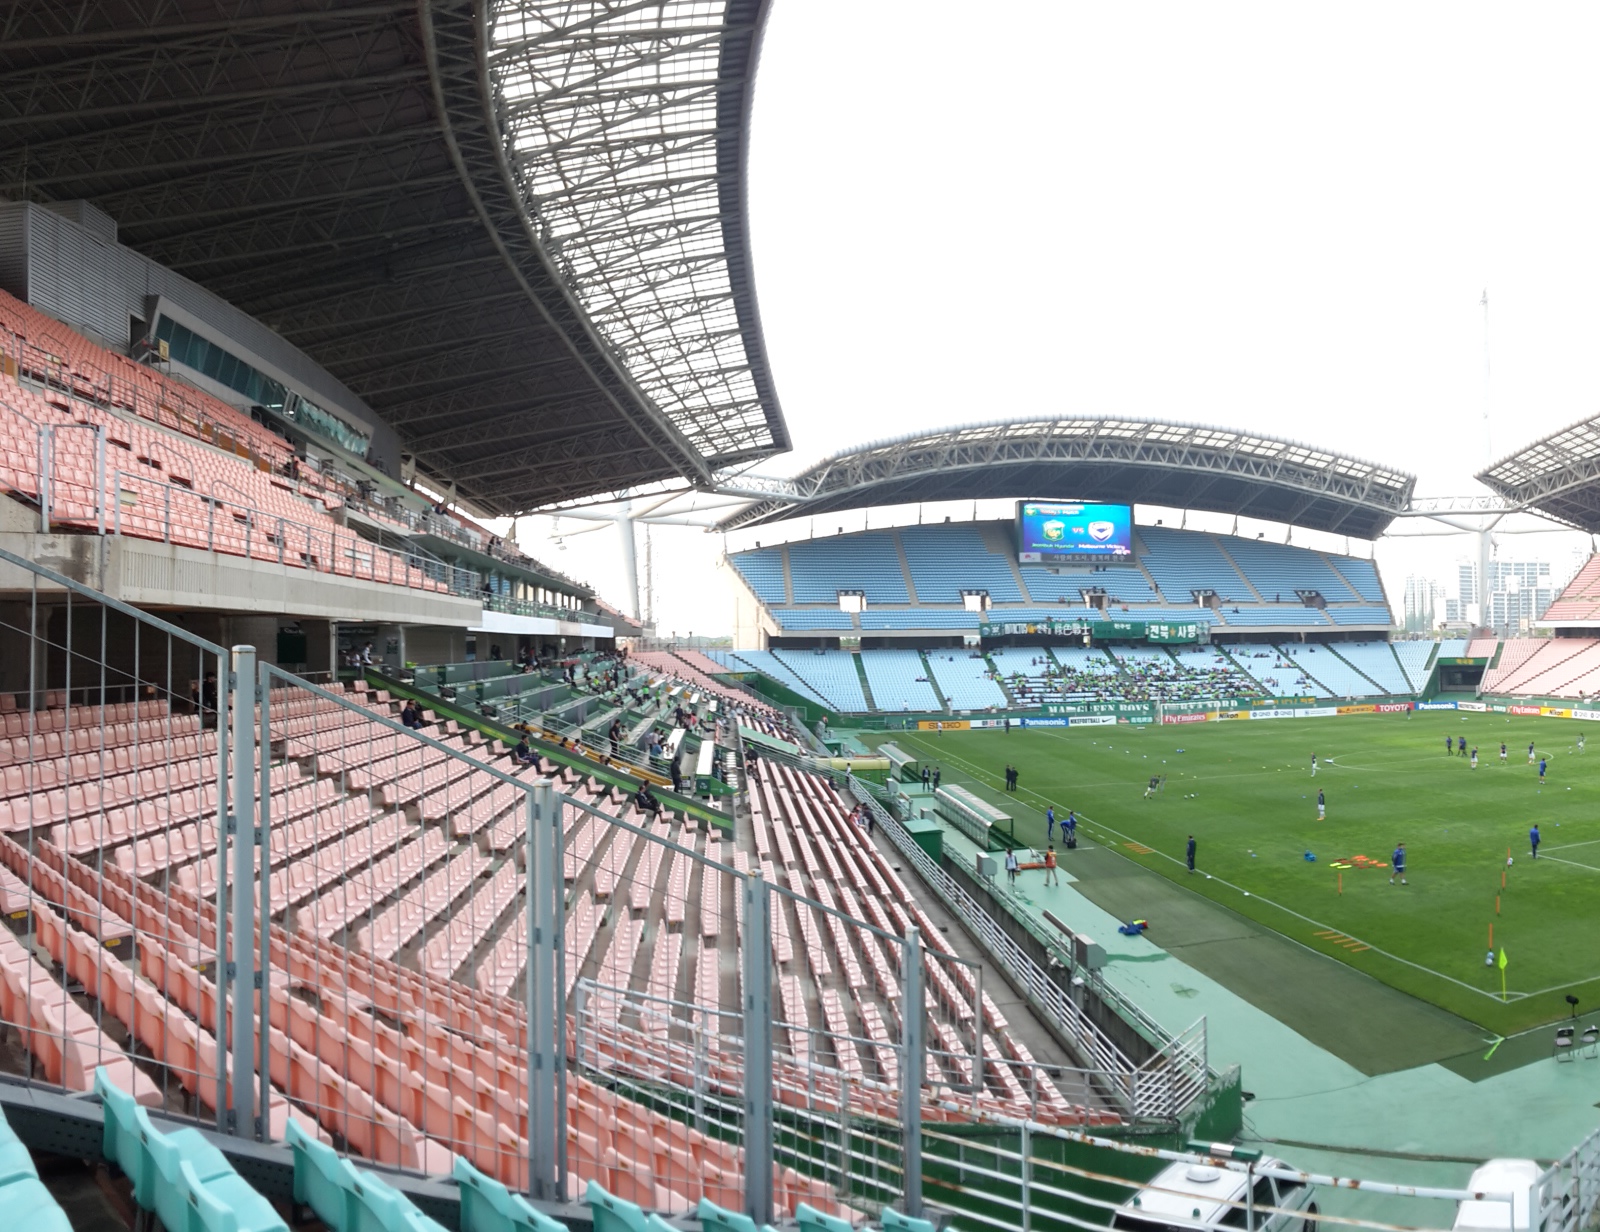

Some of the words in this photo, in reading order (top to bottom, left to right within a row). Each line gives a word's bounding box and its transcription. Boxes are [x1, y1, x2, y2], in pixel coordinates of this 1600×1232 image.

[1419, 702, 1455, 710] Panasonic
[1177, 713, 1206, 722] Emirates
[1219, 712, 1239, 720] Nikon
[1025, 718, 1067, 727] Panasonic
